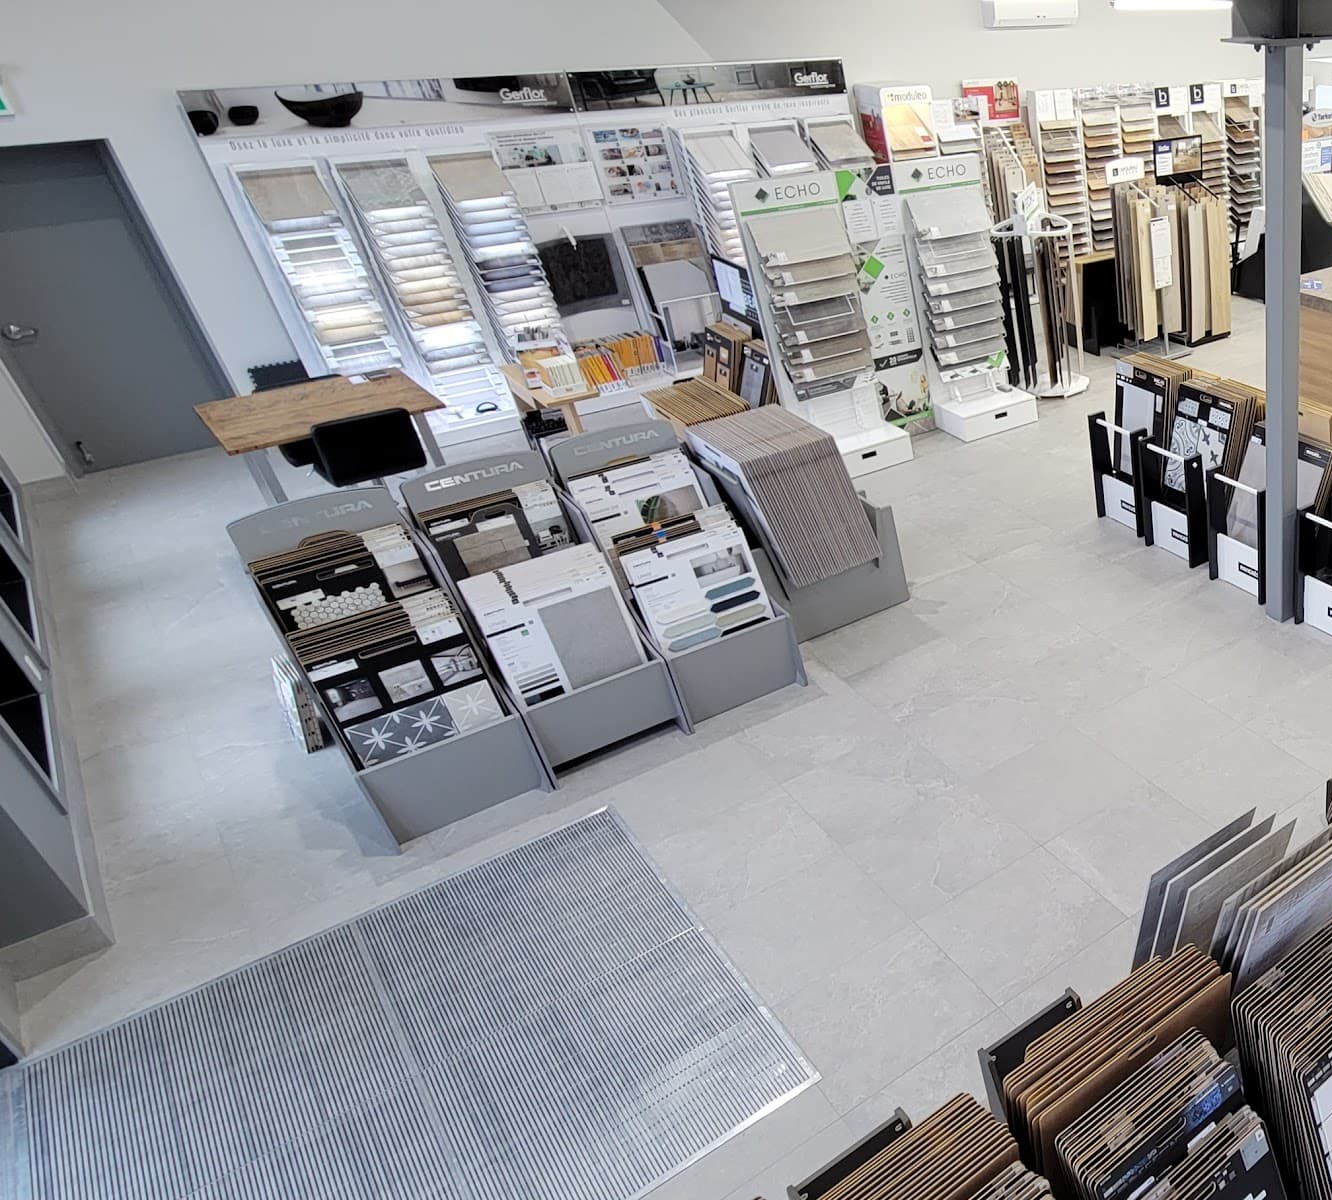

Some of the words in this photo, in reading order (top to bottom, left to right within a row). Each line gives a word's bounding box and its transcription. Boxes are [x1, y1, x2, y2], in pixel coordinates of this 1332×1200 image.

[794, 72, 828, 84] Gerflor
[499, 87, 545, 101] Gerflor
[927, 163, 967, 180] ECHO
[774, 182, 821, 200] ECHO
[573, 430, 660, 456] CNTURA
[423, 461, 524, 492] CENTURA
